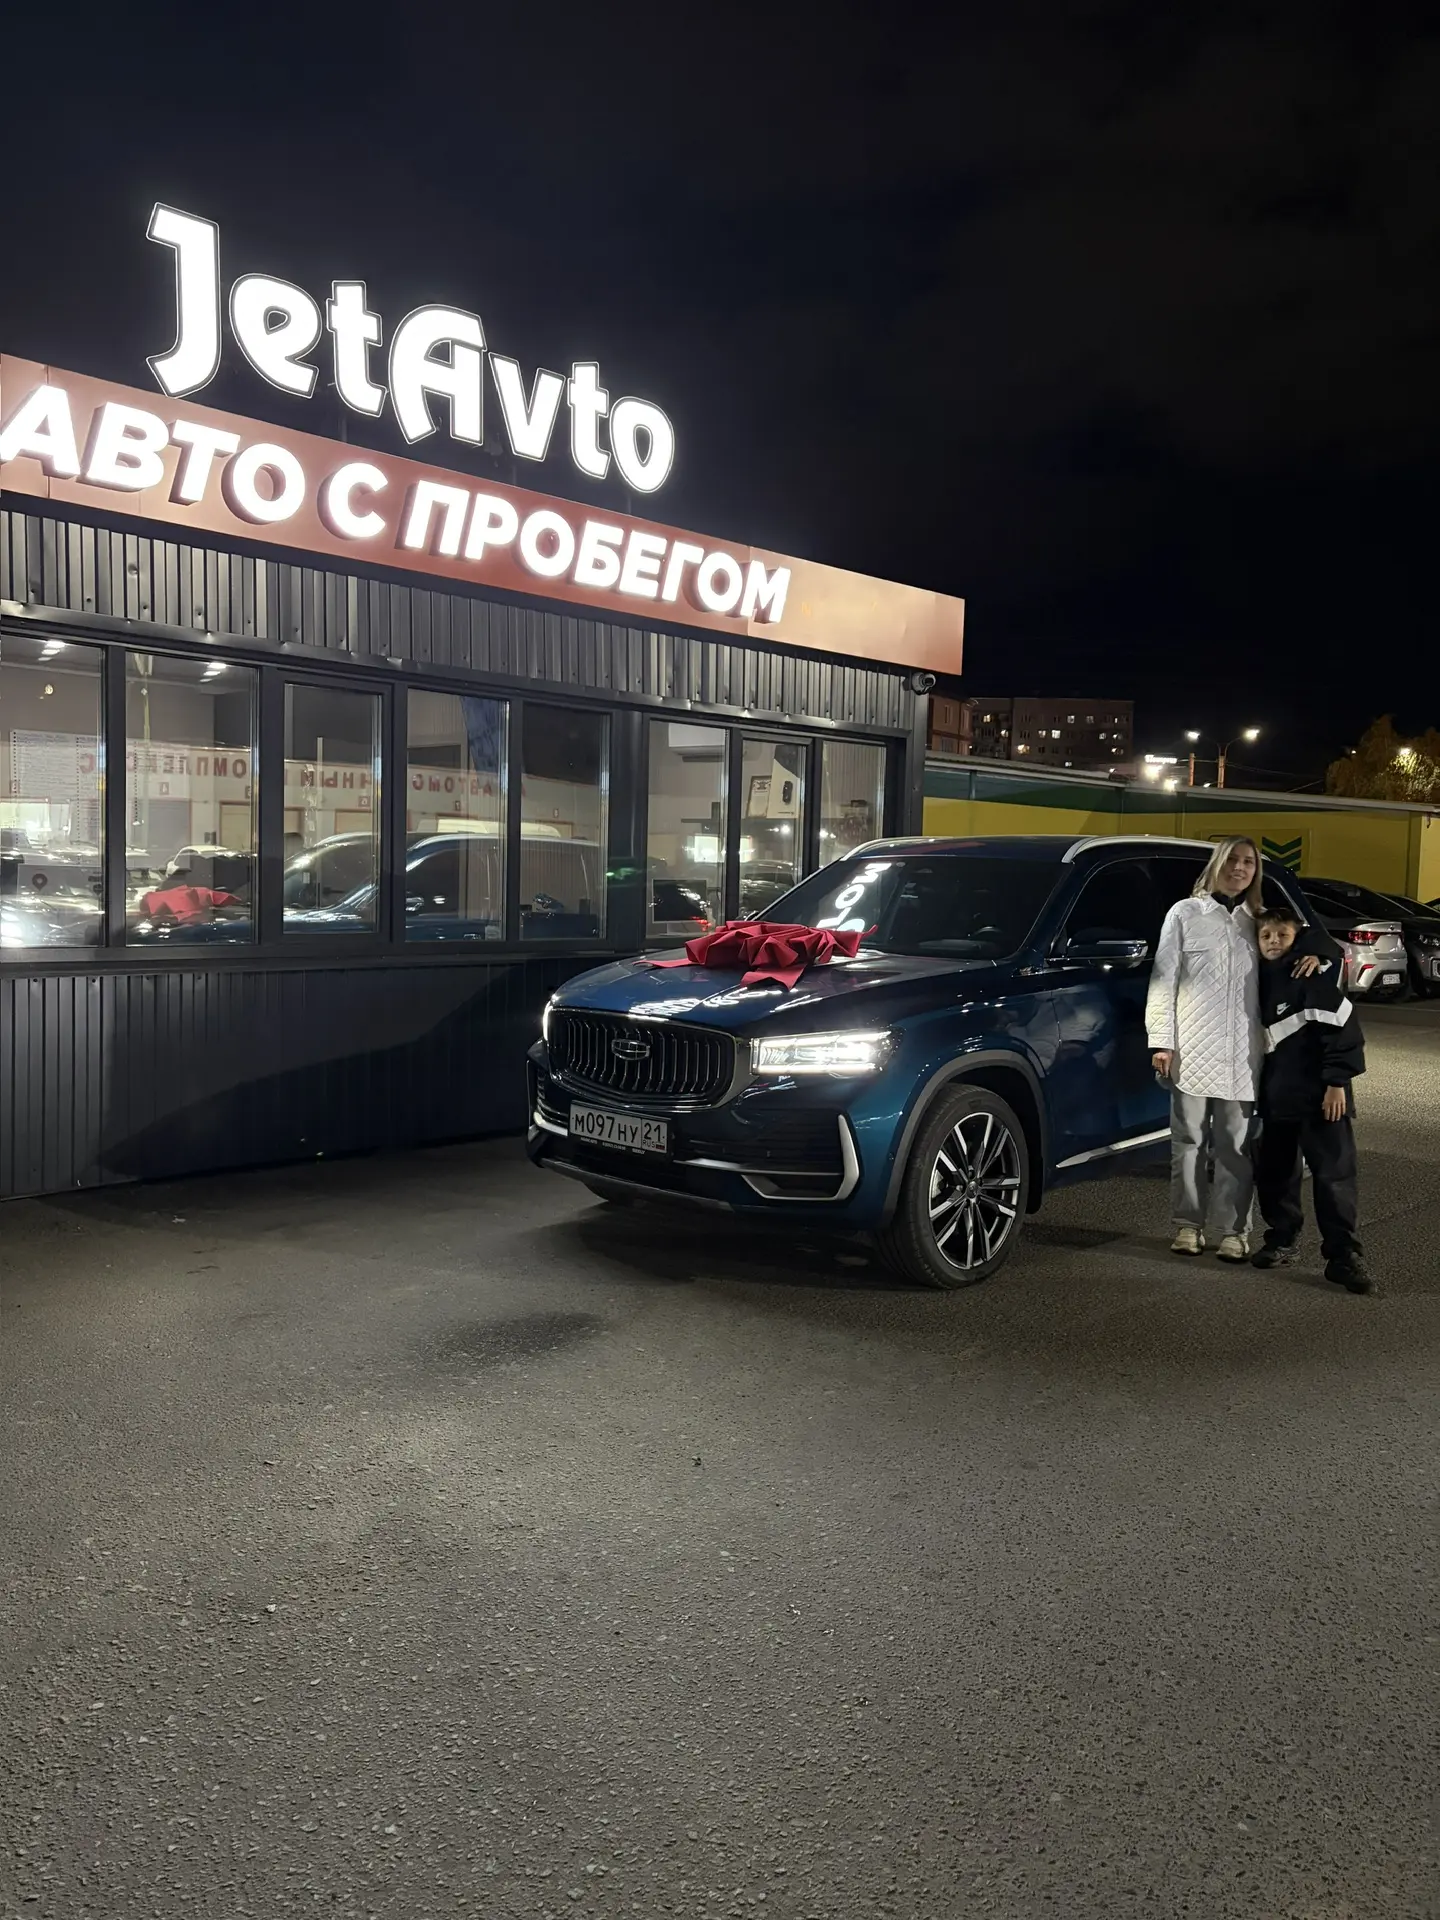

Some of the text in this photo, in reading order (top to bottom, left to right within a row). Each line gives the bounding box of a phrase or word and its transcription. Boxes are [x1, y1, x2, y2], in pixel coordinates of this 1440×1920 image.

[146, 202, 675, 493] JetAvto
[0, 383, 792, 624] АВТО С ПРОБЕГОМ
[642, 1139, 656, 1148] RUS
[643, 1122, 661, 1142] 21
